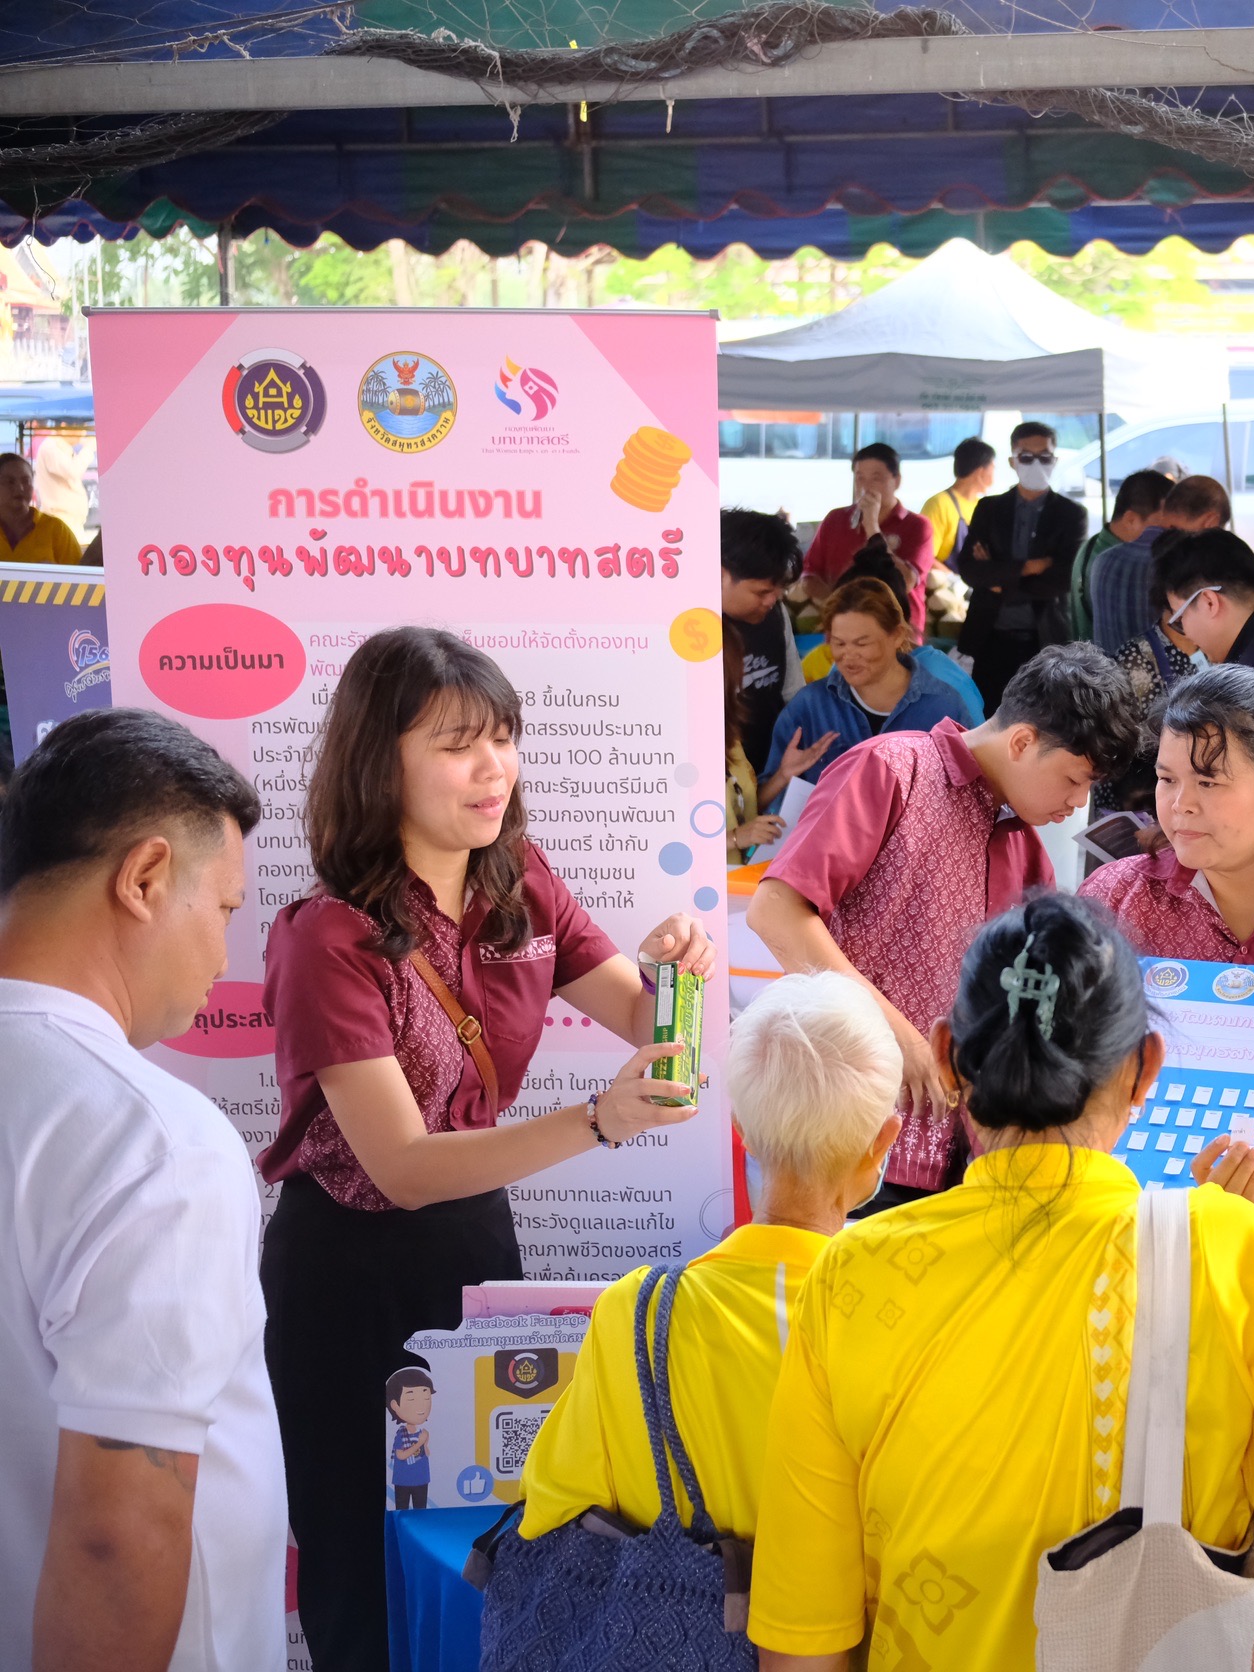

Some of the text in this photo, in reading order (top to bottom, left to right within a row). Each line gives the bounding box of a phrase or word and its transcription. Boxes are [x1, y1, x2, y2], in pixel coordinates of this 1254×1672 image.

[491, 433, 570, 446] บทบาทสตรี
[267, 477, 543, 520] การดำเนินงาน
[137, 527, 685, 592] กองทุนพัฒนาบทบาทสตรี
[159, 647, 285, 672] ความเป็นมา
[542, 684, 620, 708] ขึ้นในกรม
[567, 748, 602, 766] 100
[608, 747, 676, 766] ล้านบาท
[599, 835, 649, 852] เข้ากับ
[466, 1314, 587, 1330] Facebook Fanpage
